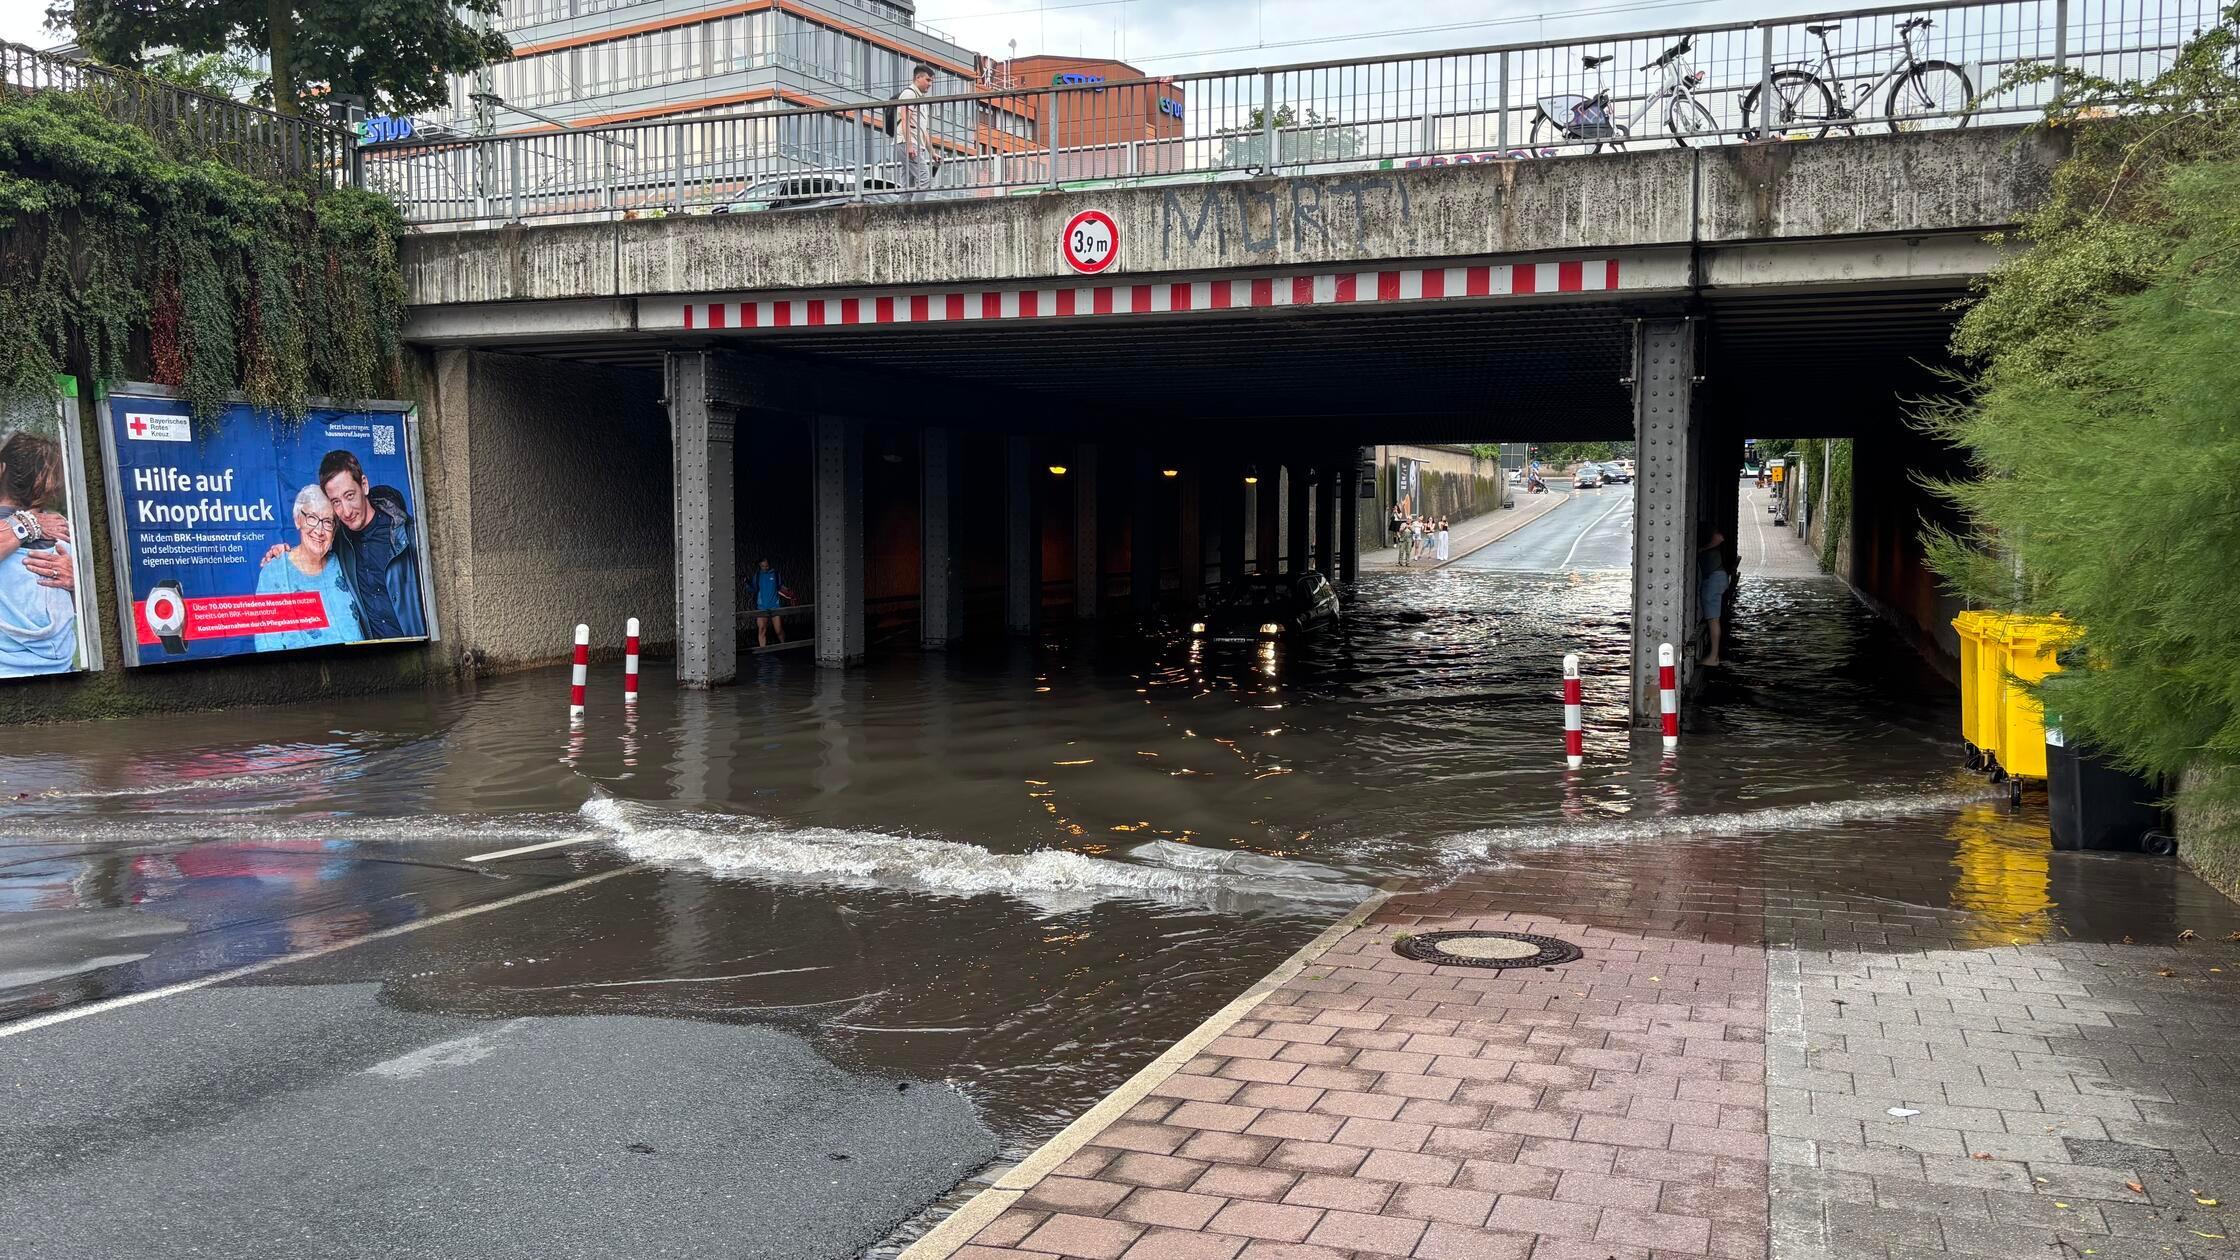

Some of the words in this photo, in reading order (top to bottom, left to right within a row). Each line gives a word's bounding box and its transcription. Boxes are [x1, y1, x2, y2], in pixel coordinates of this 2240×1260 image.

[1074, 230, 1094, 254] 3,9
[1096, 239, 1108, 252] m
[150, 417, 187, 425] Bayerisches
[134, 467, 192, 492] Hilfe
[195, 468, 234, 492] auf
[138, 498, 275, 528] Knopfdruck
[140, 533, 155, 542] Mit
[155, 533, 173, 542] dem
[174, 532, 241, 542] BRK-Hausnotruf
[242, 531, 265, 541] sicher
[141, 545, 157, 554] und
[158, 544, 219, 554] selbstbestimmt
[219, 543, 227, 552] in
[228, 543, 243, 552] den
[142, 557, 175, 568] eigenen
[175, 556, 190, 565] vier
[190, 555, 223, 564] Wänden
[223, 554, 248, 563] leben.
[192, 602, 208, 611] Über
[209, 602, 232, 610] 70.000
[233, 601, 265, 609] zufriedene
[266, 599, 296, 607] Menschen
